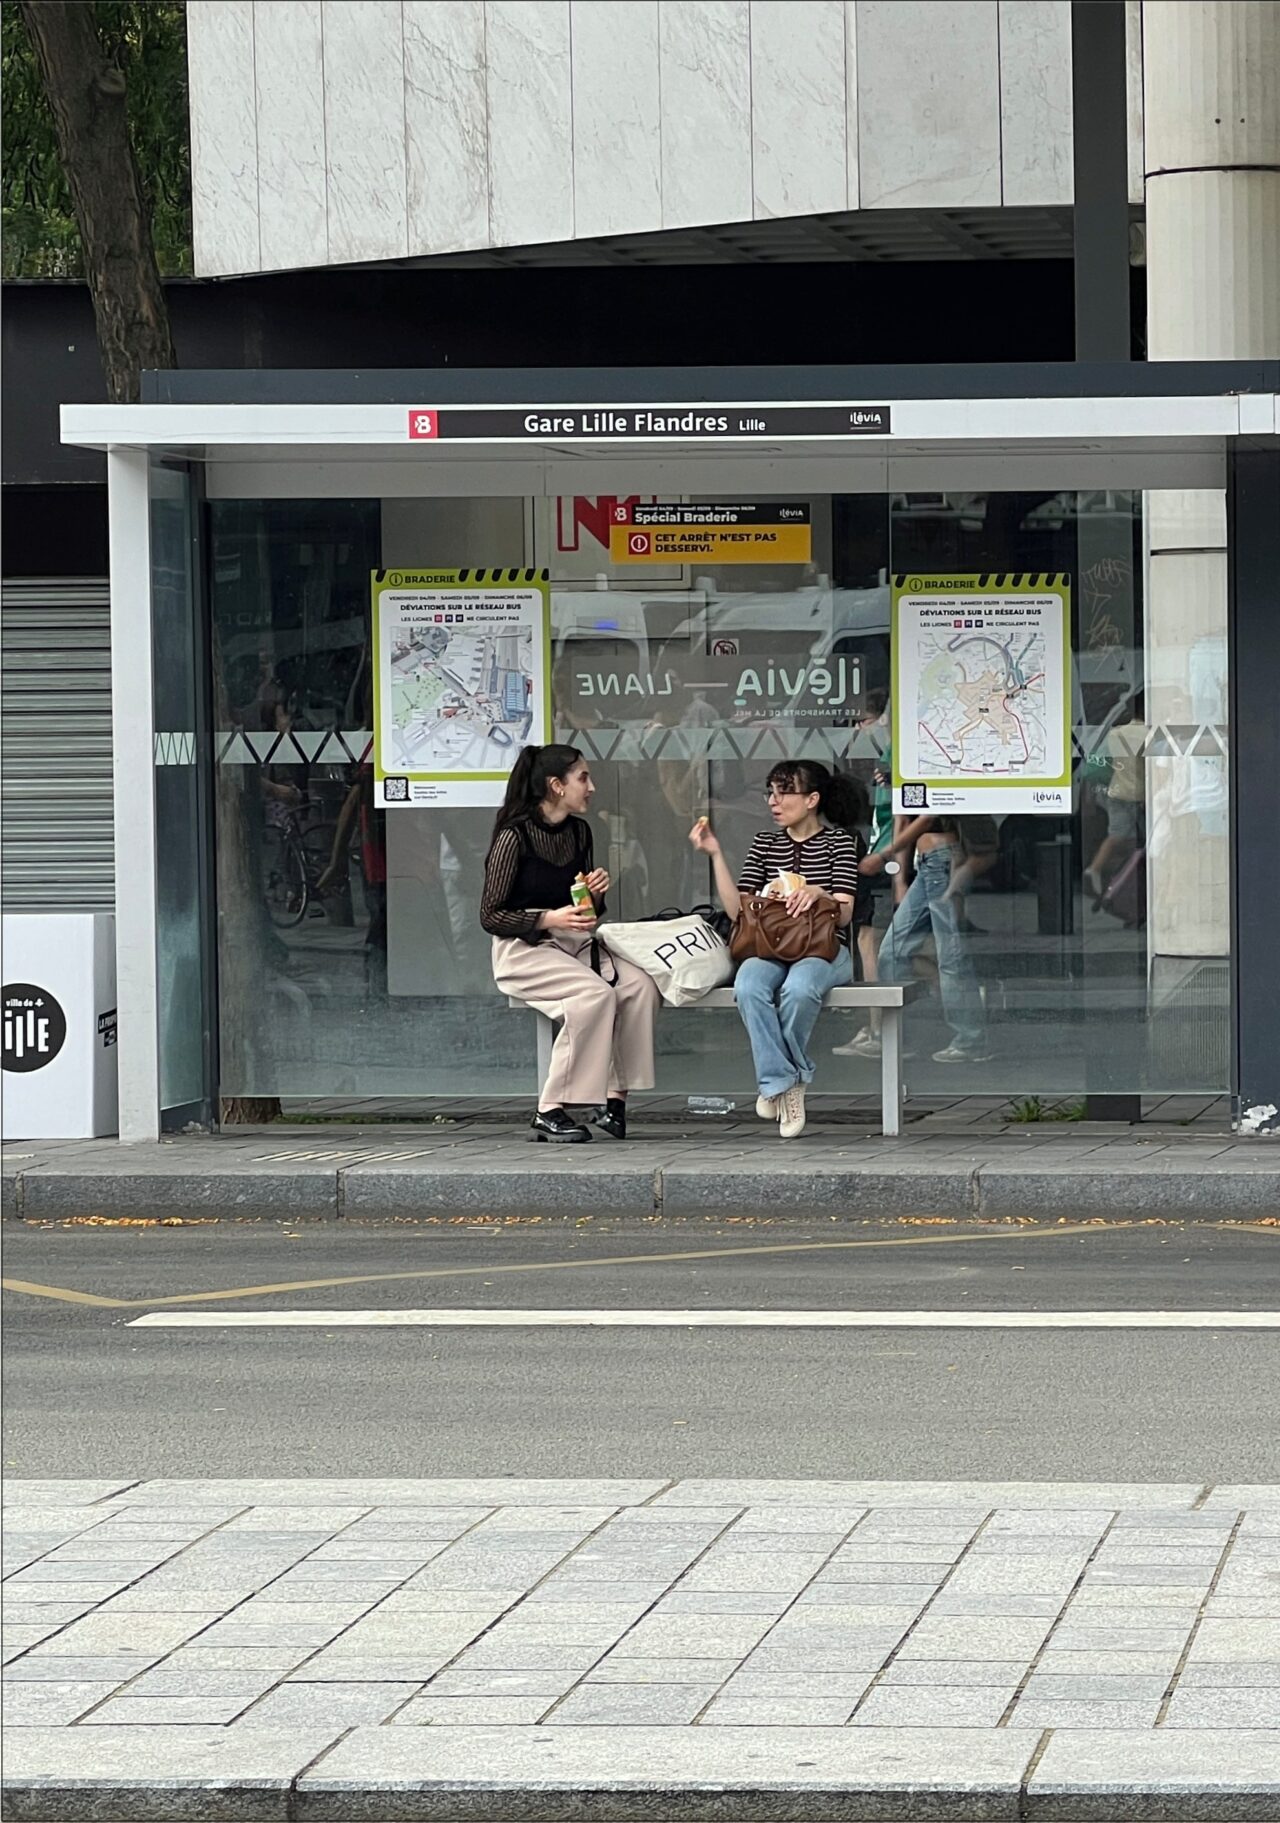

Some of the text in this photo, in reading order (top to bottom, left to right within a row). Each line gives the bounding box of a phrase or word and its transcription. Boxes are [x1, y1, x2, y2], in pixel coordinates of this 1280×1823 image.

[524, 412, 766, 432] Gare Lille Flandres Lille
[635, 511, 738, 525] Spécial Braderie
[655, 531, 777, 542] CET ARRÊT N'EST PAS
[655, 544, 714, 553] DESSERVI.
[404, 575, 455, 583] BRADERIE
[475, 602, 505, 610] RÉSEAU
[5, 998, 33, 1007] ville de
